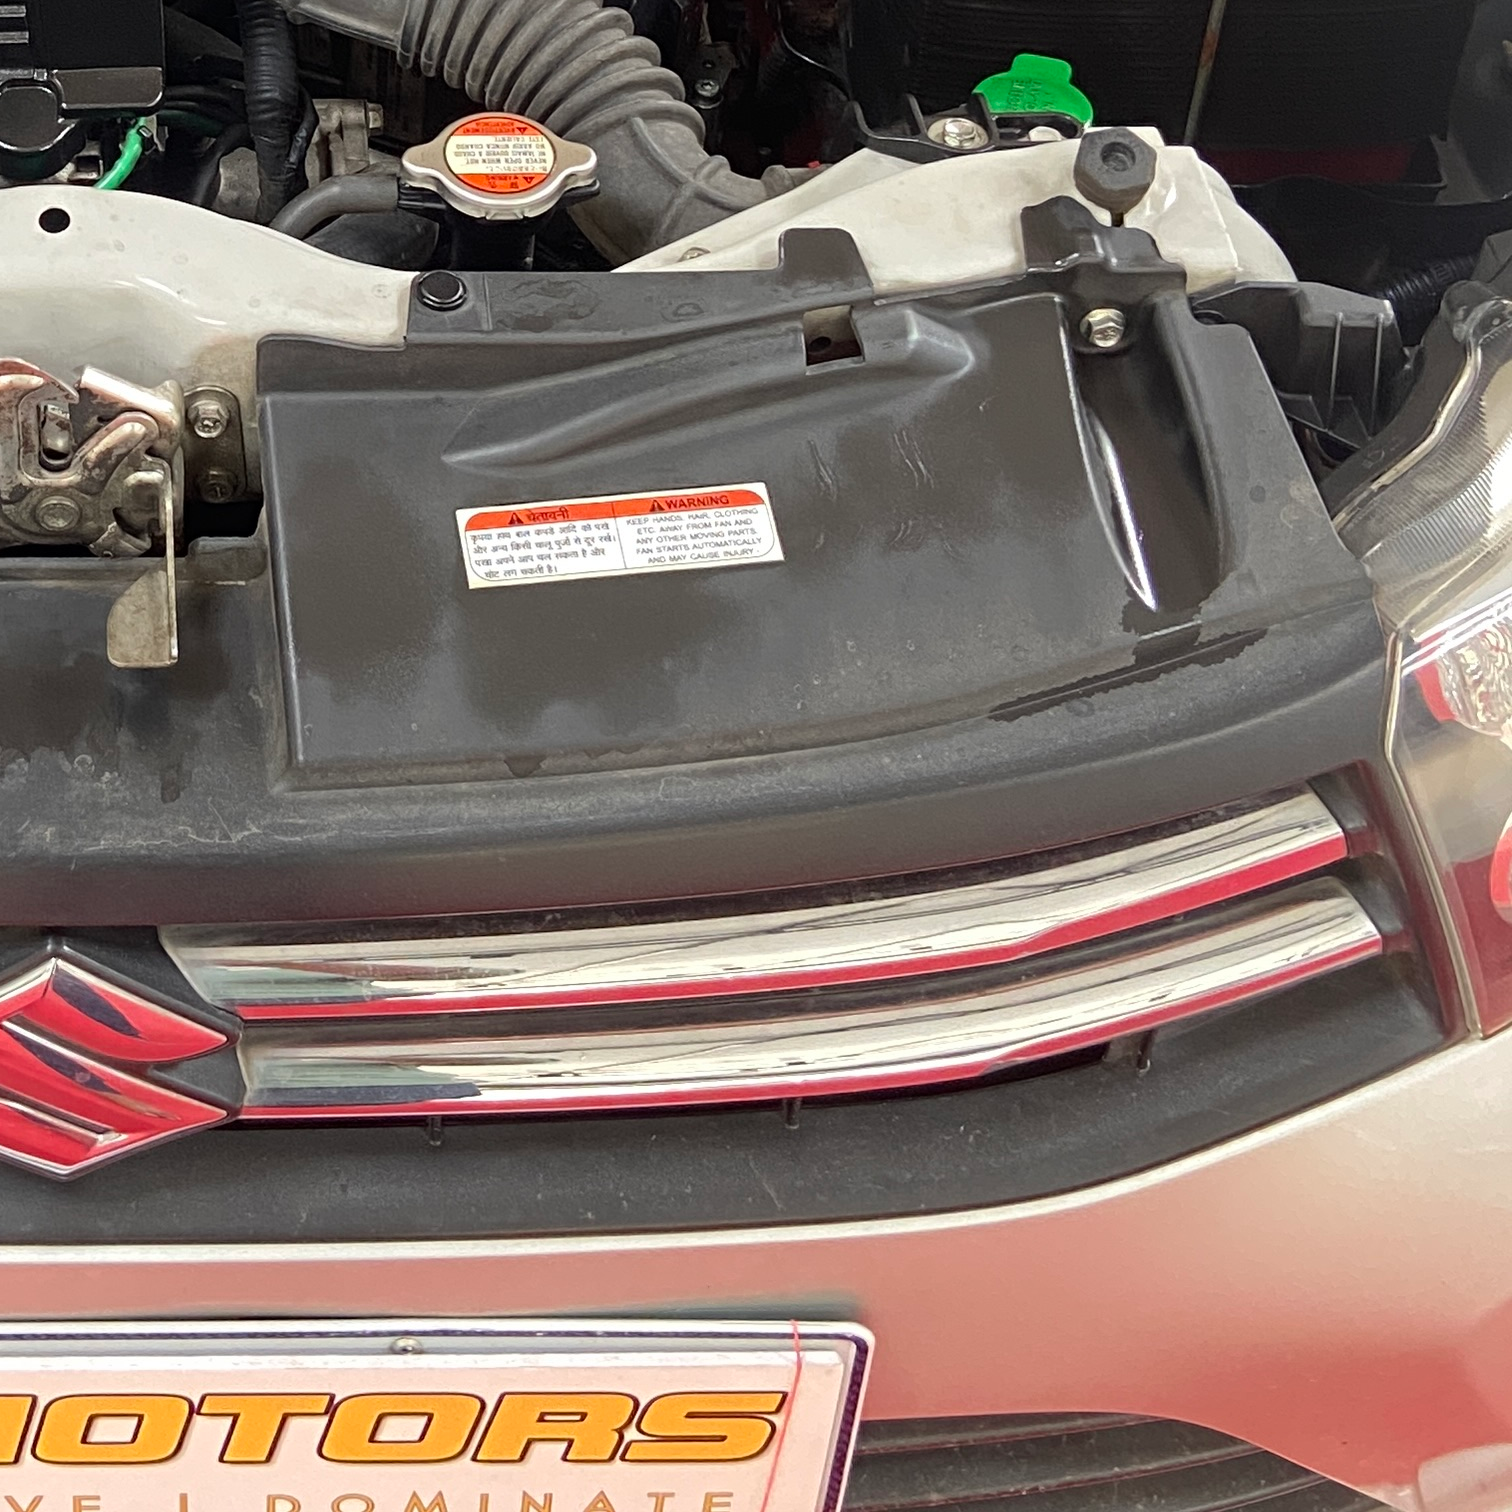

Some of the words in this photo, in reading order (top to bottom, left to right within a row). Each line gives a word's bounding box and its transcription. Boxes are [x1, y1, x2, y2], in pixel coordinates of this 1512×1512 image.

[665, 495, 730, 510] WARNING
[526, 508, 569, 523] चेतावनी
[626, 517, 649, 526] KEEP
[714, 508, 759, 518] CLOTHING
[659, 524, 683, 533] AWAY
[686, 521, 711, 531] FROM
[715, 520, 731, 528] FAN
[734, 518, 752, 526] AND
[636, 536, 653, 544] ANY
[656, 533, 687, 543] OTHER
[690, 530, 725, 540] MOVING
[636, 547, 653, 555] FAN
[656, 544, 689, 554] STARTS
[692, 538, 762, 550] AUTOMATICALLY
[648, 556, 666, 564] AND
[669, 554, 686, 562] MAY
[690, 551, 720, 560] CAUSE
